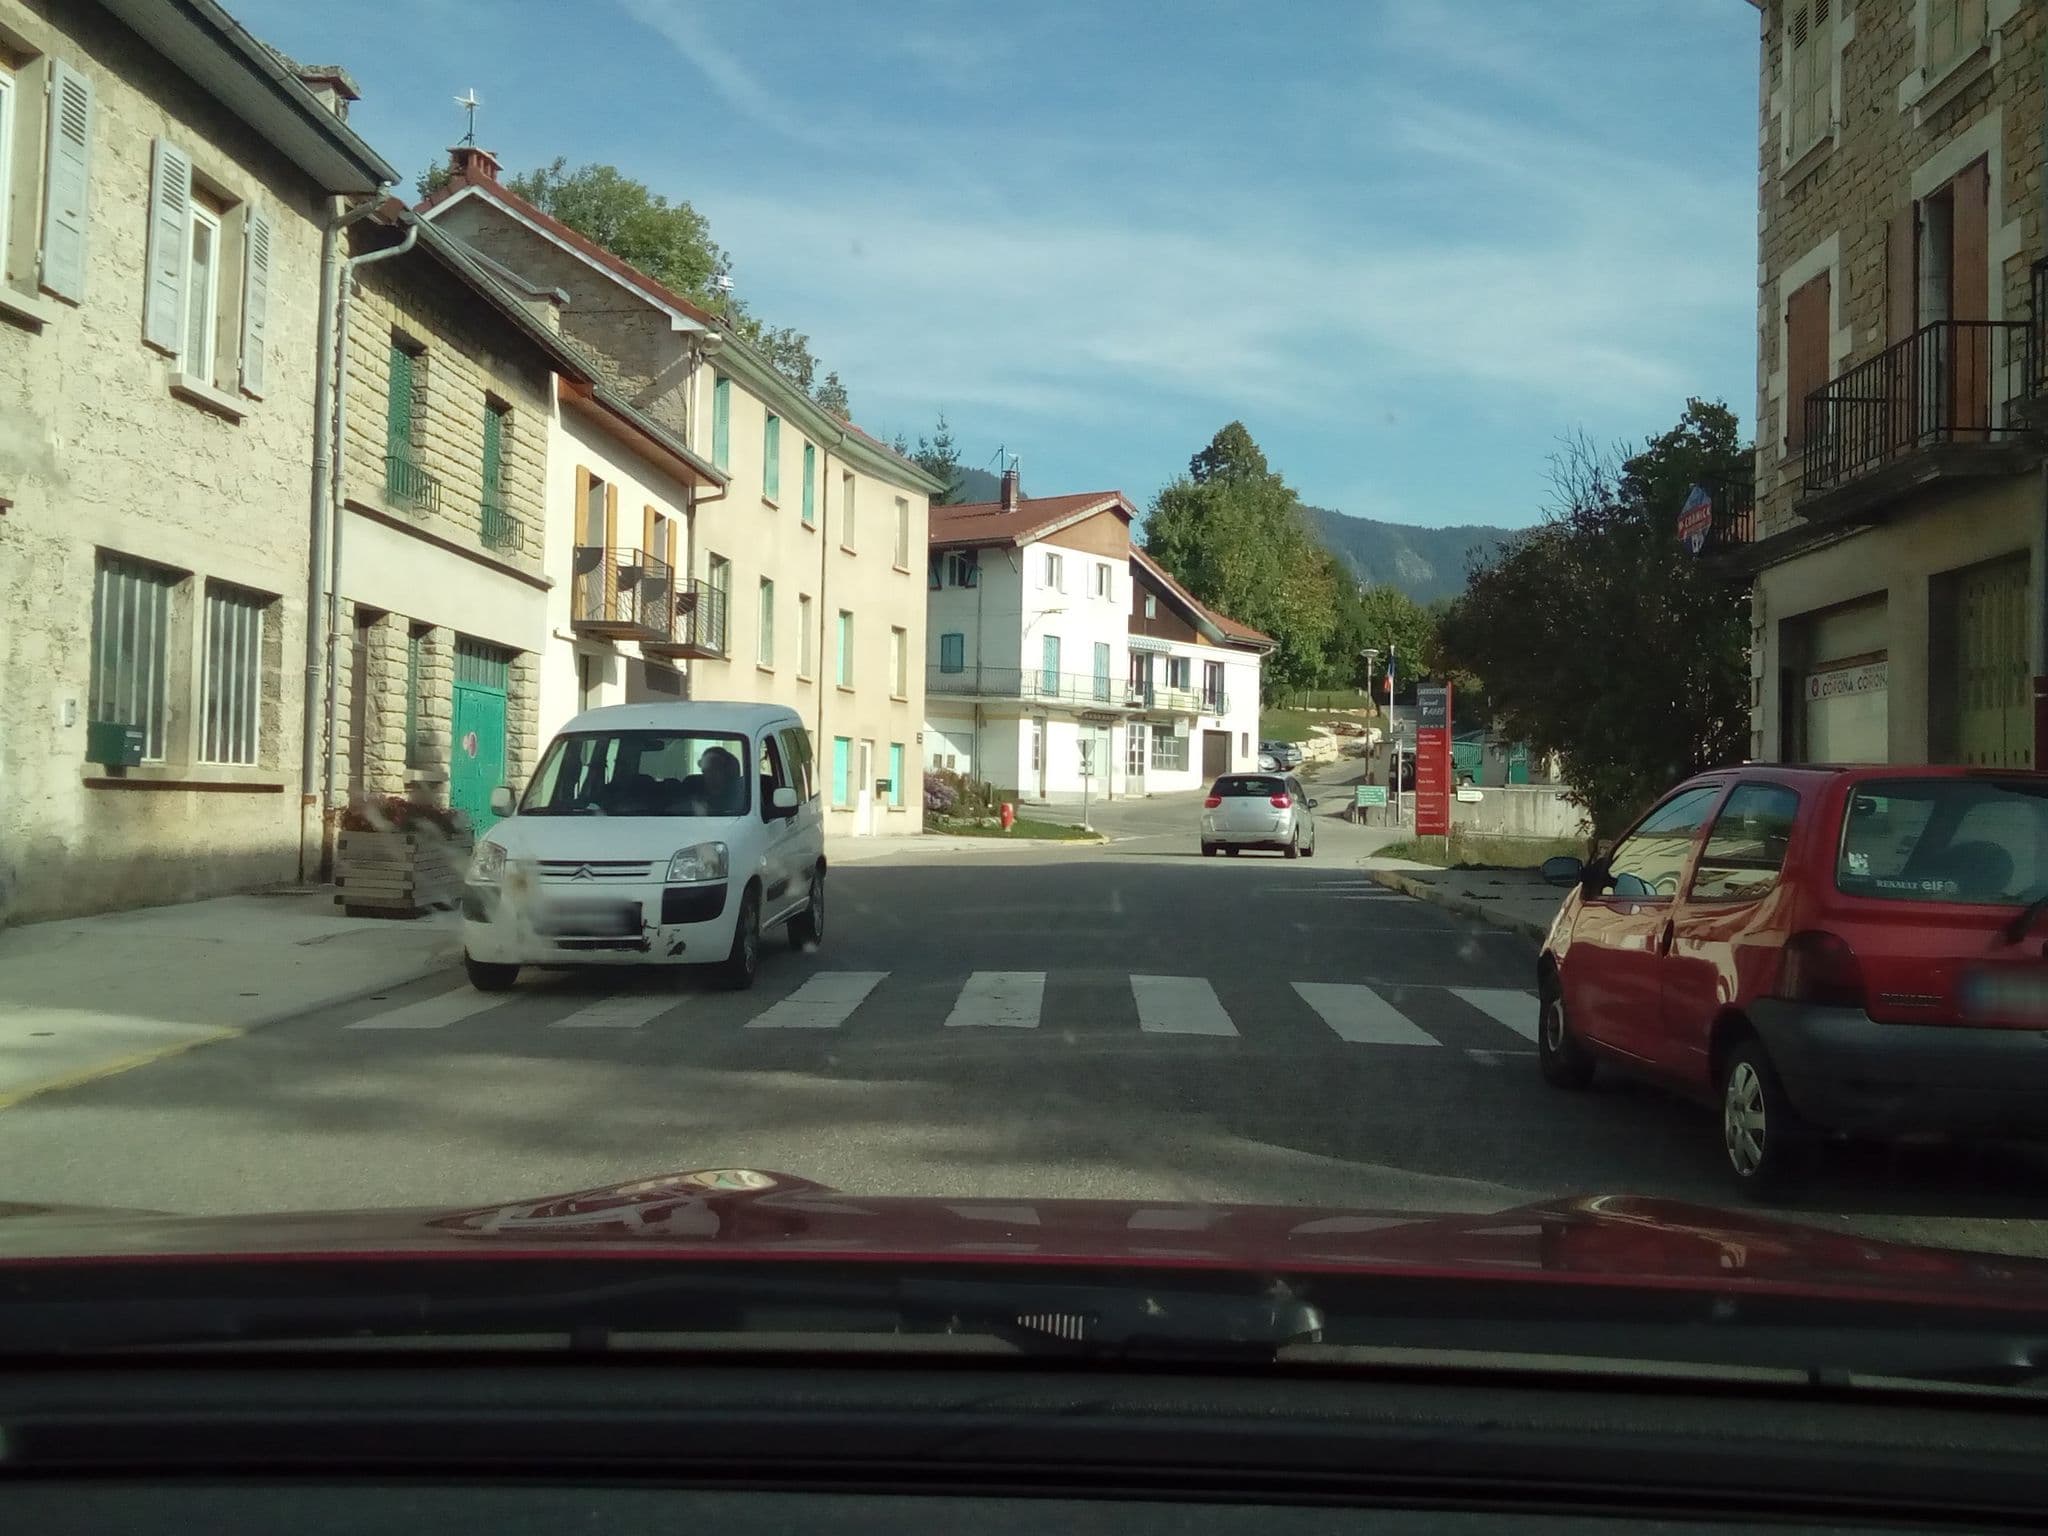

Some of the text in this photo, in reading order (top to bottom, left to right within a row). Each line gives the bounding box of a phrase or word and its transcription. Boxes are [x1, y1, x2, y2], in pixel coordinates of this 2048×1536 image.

[1823, 679, 1854, 696] CORONA
[1858, 672, 1888, 690] CORON
[1877, 880, 1919, 890] RENAULT
